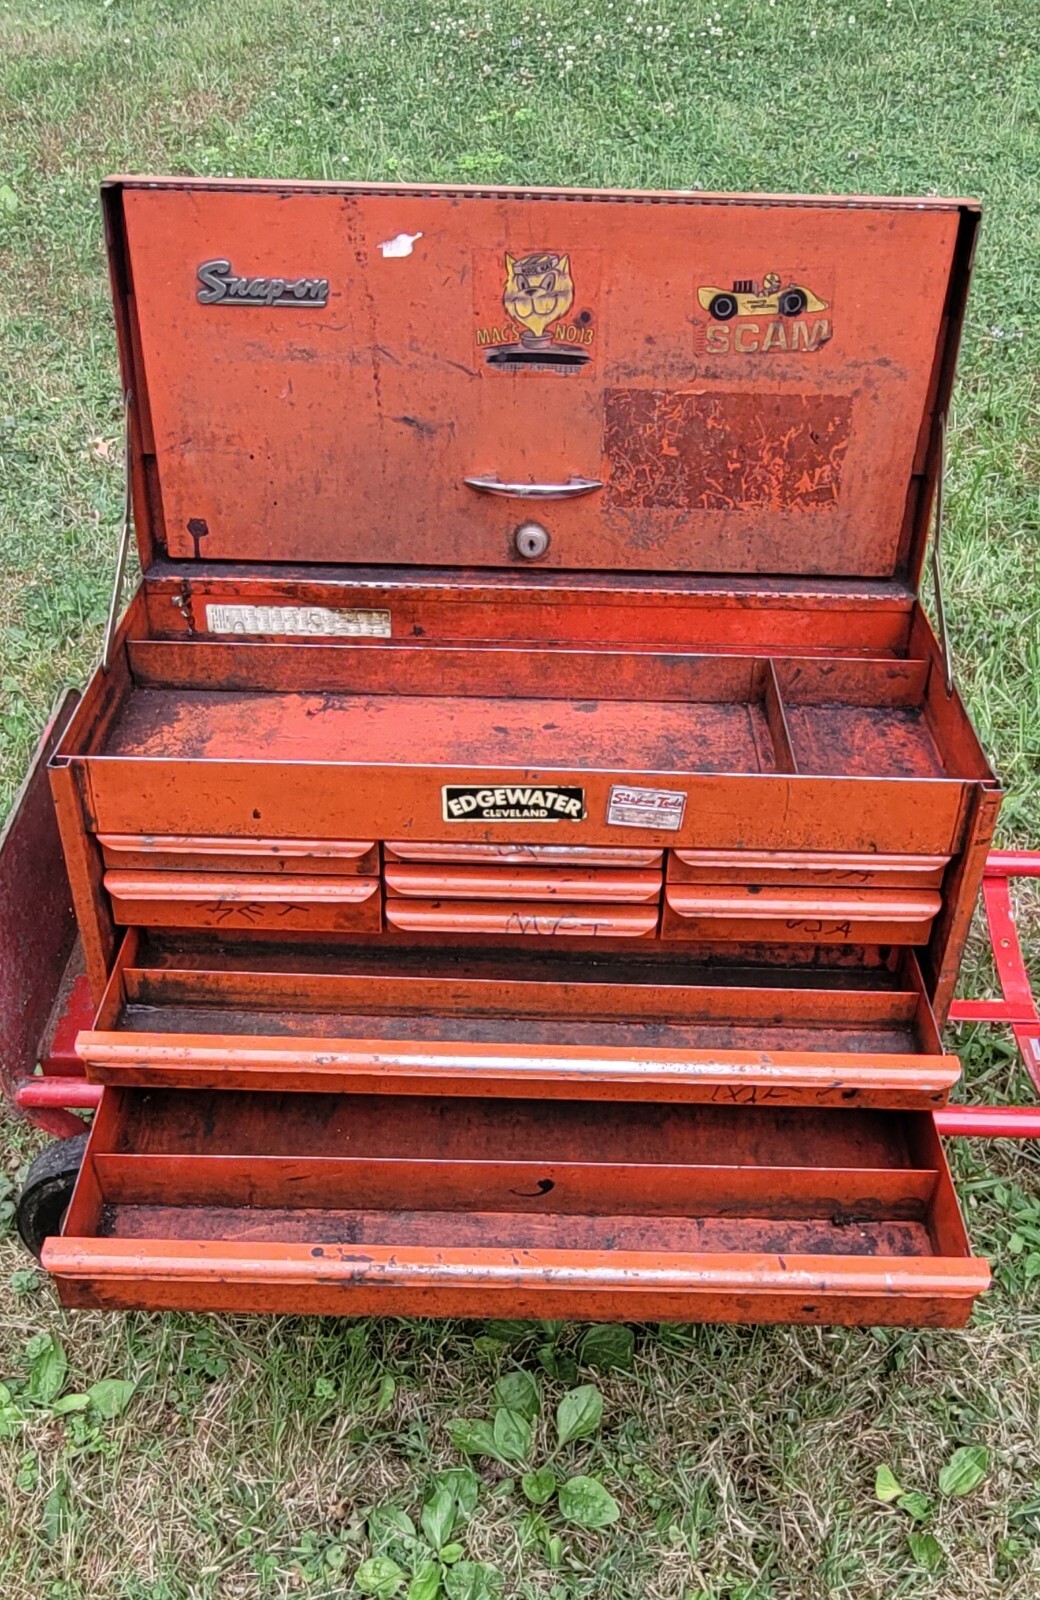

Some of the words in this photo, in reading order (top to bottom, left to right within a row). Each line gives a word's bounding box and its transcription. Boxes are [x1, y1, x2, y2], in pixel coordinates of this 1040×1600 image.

[197, 259, 329, 305] Snap-on
[476, 324, 520, 345] MAC'S
[705, 319, 829, 353] SCAM
[447, 788, 582, 817] EDGEWATER
[482, 808, 549, 818] CLEVELAND
